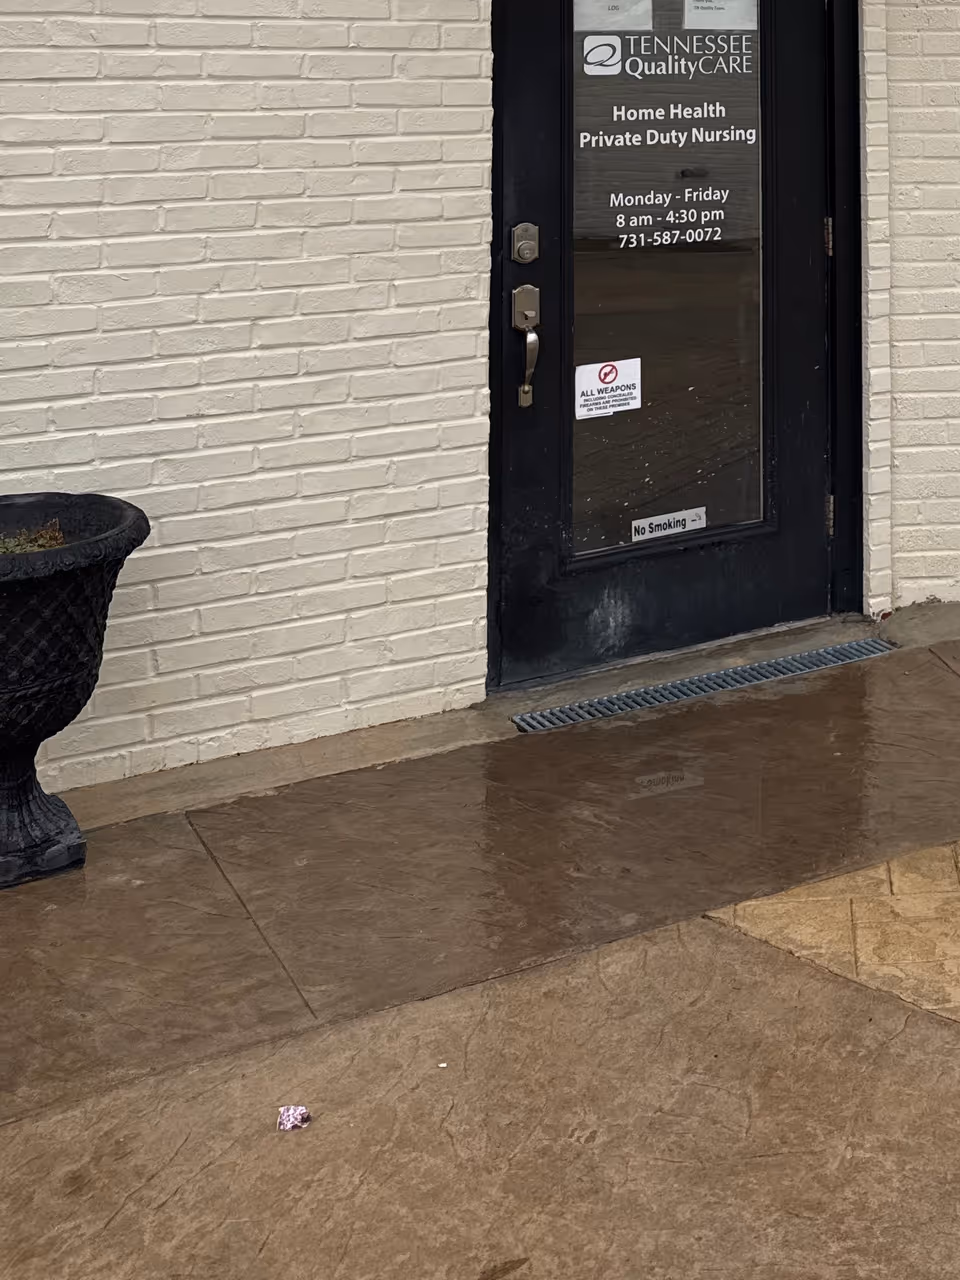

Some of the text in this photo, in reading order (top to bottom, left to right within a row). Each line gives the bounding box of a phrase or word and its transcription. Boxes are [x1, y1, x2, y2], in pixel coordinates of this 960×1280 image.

[625, 34, 753, 55] TENNESSEE
[625, 55, 753, 80] QualityCARE
[612, 102, 726, 122] Home Health
[579, 125, 757, 148] Private Duty Nursing
[609, 190, 672, 208] Monday
[684, 186, 730, 204] Friday
[616, 214, 626, 228] 8
[629, 215, 653, 227] am
[665, 209, 698, 224] 4:30
[701, 208, 725, 224] pm
[618, 227, 722, 248] 731-587-0072
[580, 383, 637, 398] ALL WEAPONS
[634, 517, 687, 537] No Smoking
